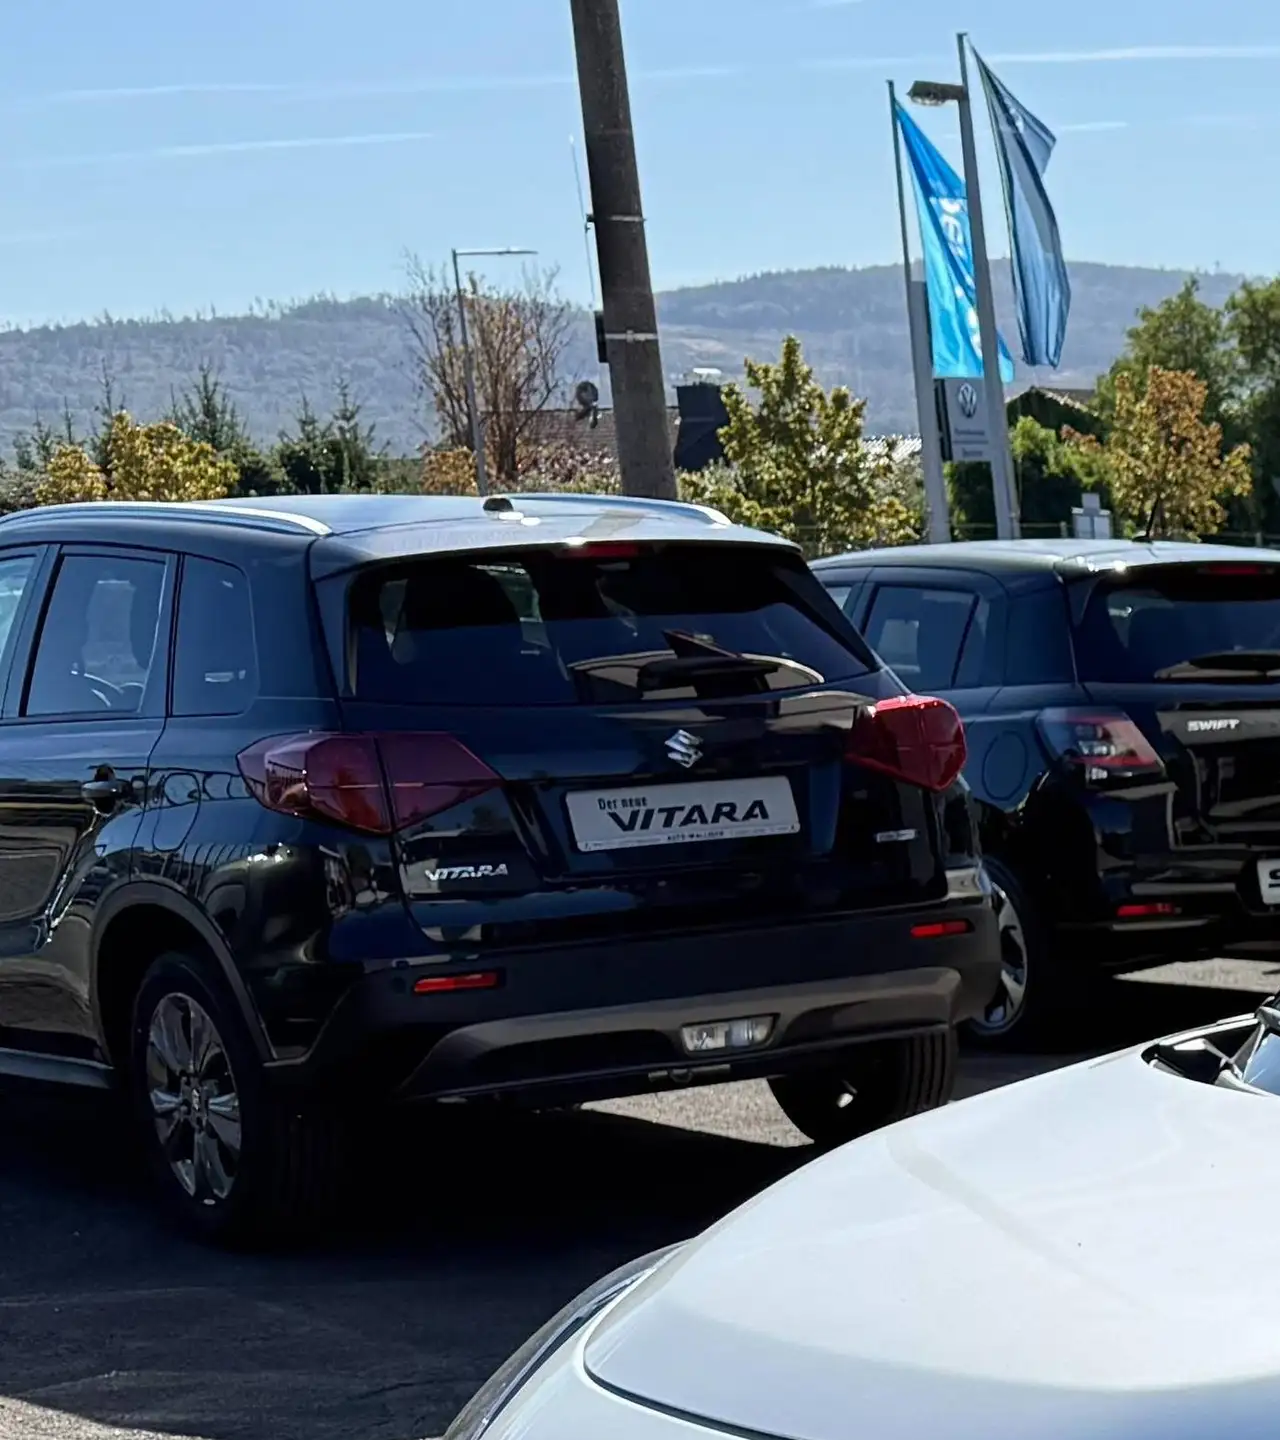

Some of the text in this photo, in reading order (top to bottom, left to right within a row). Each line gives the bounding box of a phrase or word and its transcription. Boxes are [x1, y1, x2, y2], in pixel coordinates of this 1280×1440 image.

[1187, 719, 1240, 732] SWIFT
[598, 796, 648, 811] Der neue
[607, 800, 770, 832] VITARA
[424, 864, 509, 881] VITARA
